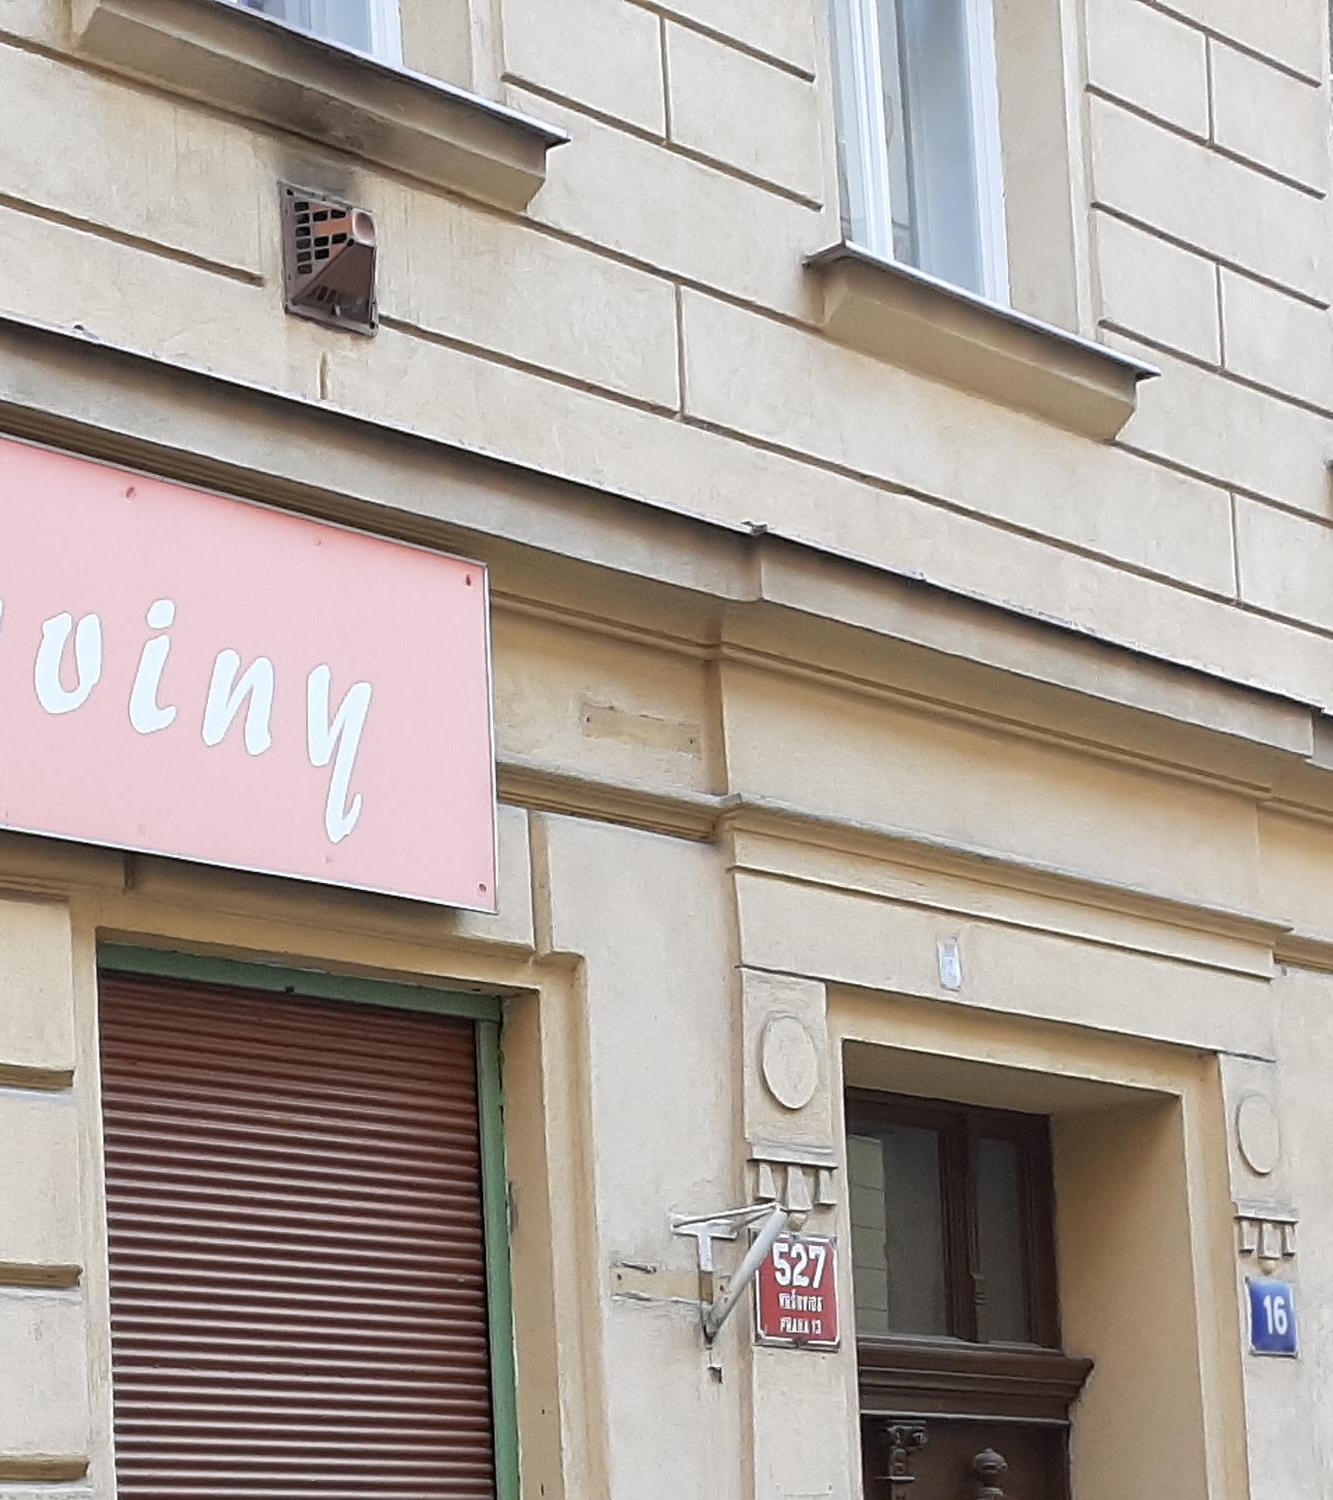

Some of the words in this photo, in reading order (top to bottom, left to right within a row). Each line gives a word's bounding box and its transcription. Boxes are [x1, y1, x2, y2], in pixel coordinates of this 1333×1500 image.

[773, 1243, 826, 1289] 527
[779, 1316, 810, 1334] PRAHA
[1263, 1294, 1288, 1335] 16
